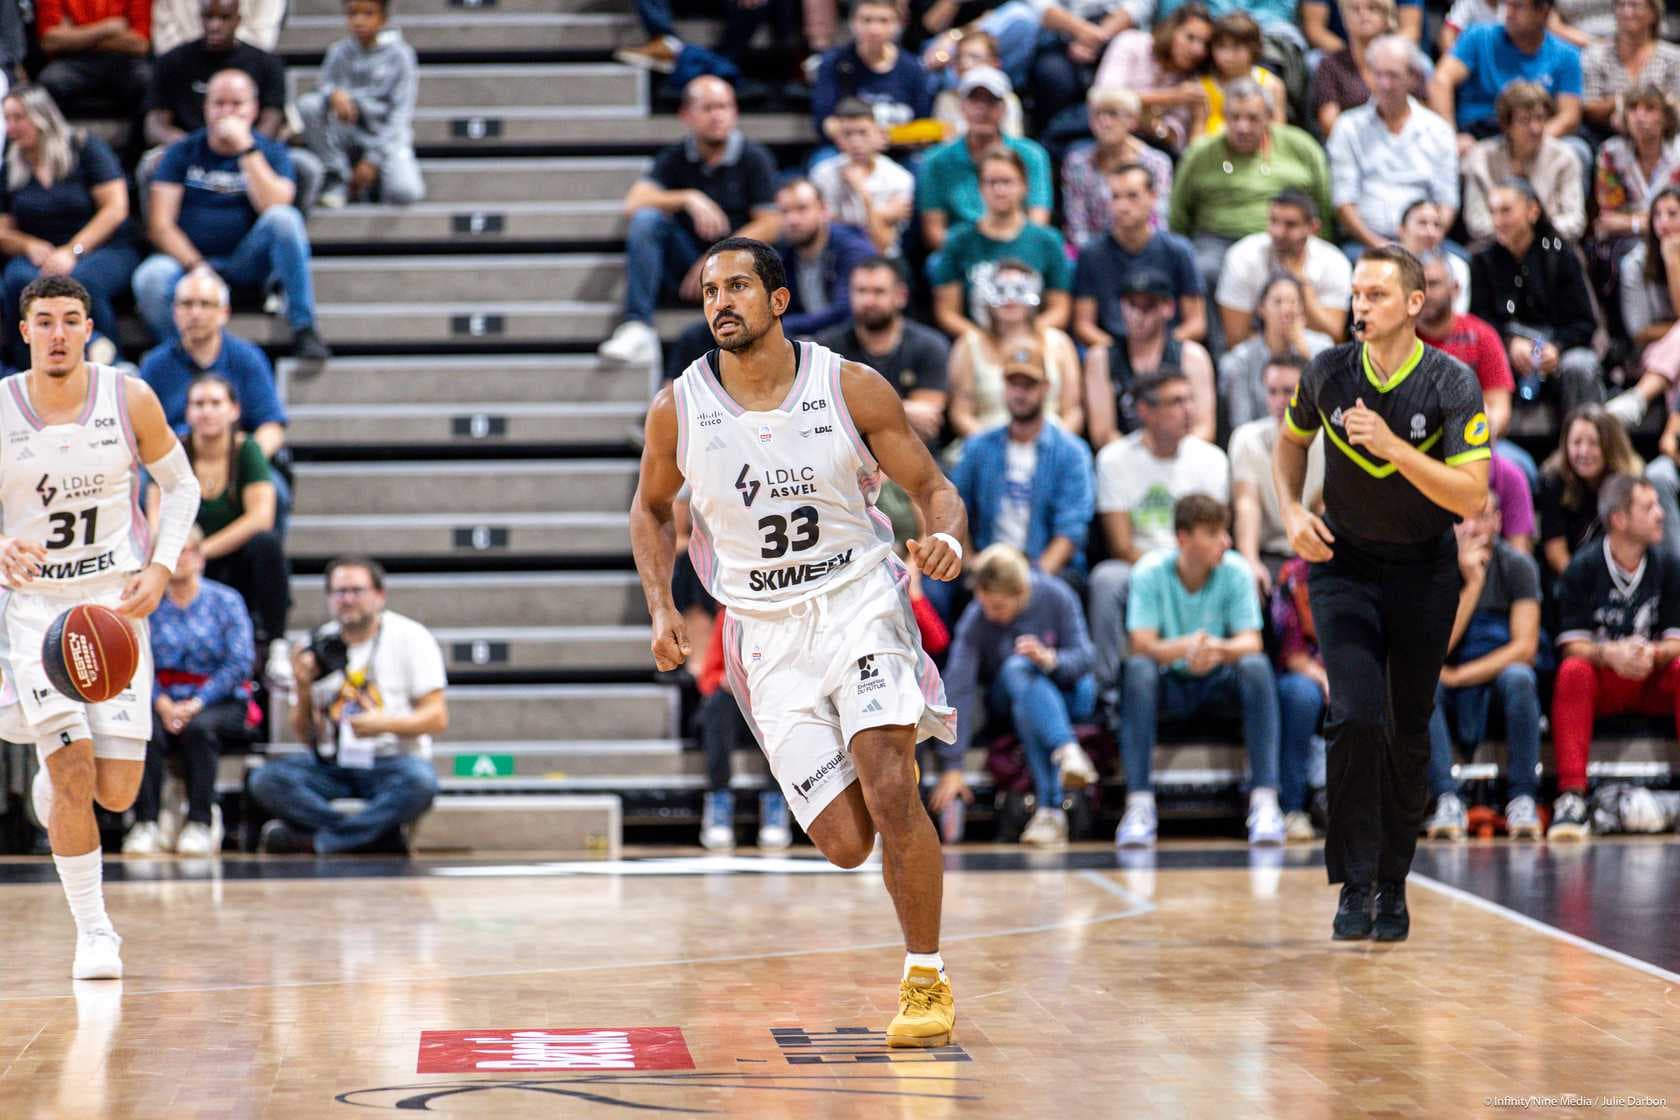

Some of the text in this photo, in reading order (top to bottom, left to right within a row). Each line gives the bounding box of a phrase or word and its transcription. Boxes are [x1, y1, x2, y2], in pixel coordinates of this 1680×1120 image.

[802, 400, 827, 412] DCB
[699, 418, 722, 427] CISCO
[62, 474, 105, 490] LDLC
[766, 466, 815, 485] LDLC
[770, 483, 817, 498] ASVEL
[46, 506, 98, 549] 31
[758, 505, 820, 559] 33
[34, 551, 115, 579] KWEE
[68, 632, 92, 688] LEGACY
[472, 753, 497, 777] A
[463, 1031, 636, 1069] Betclic
